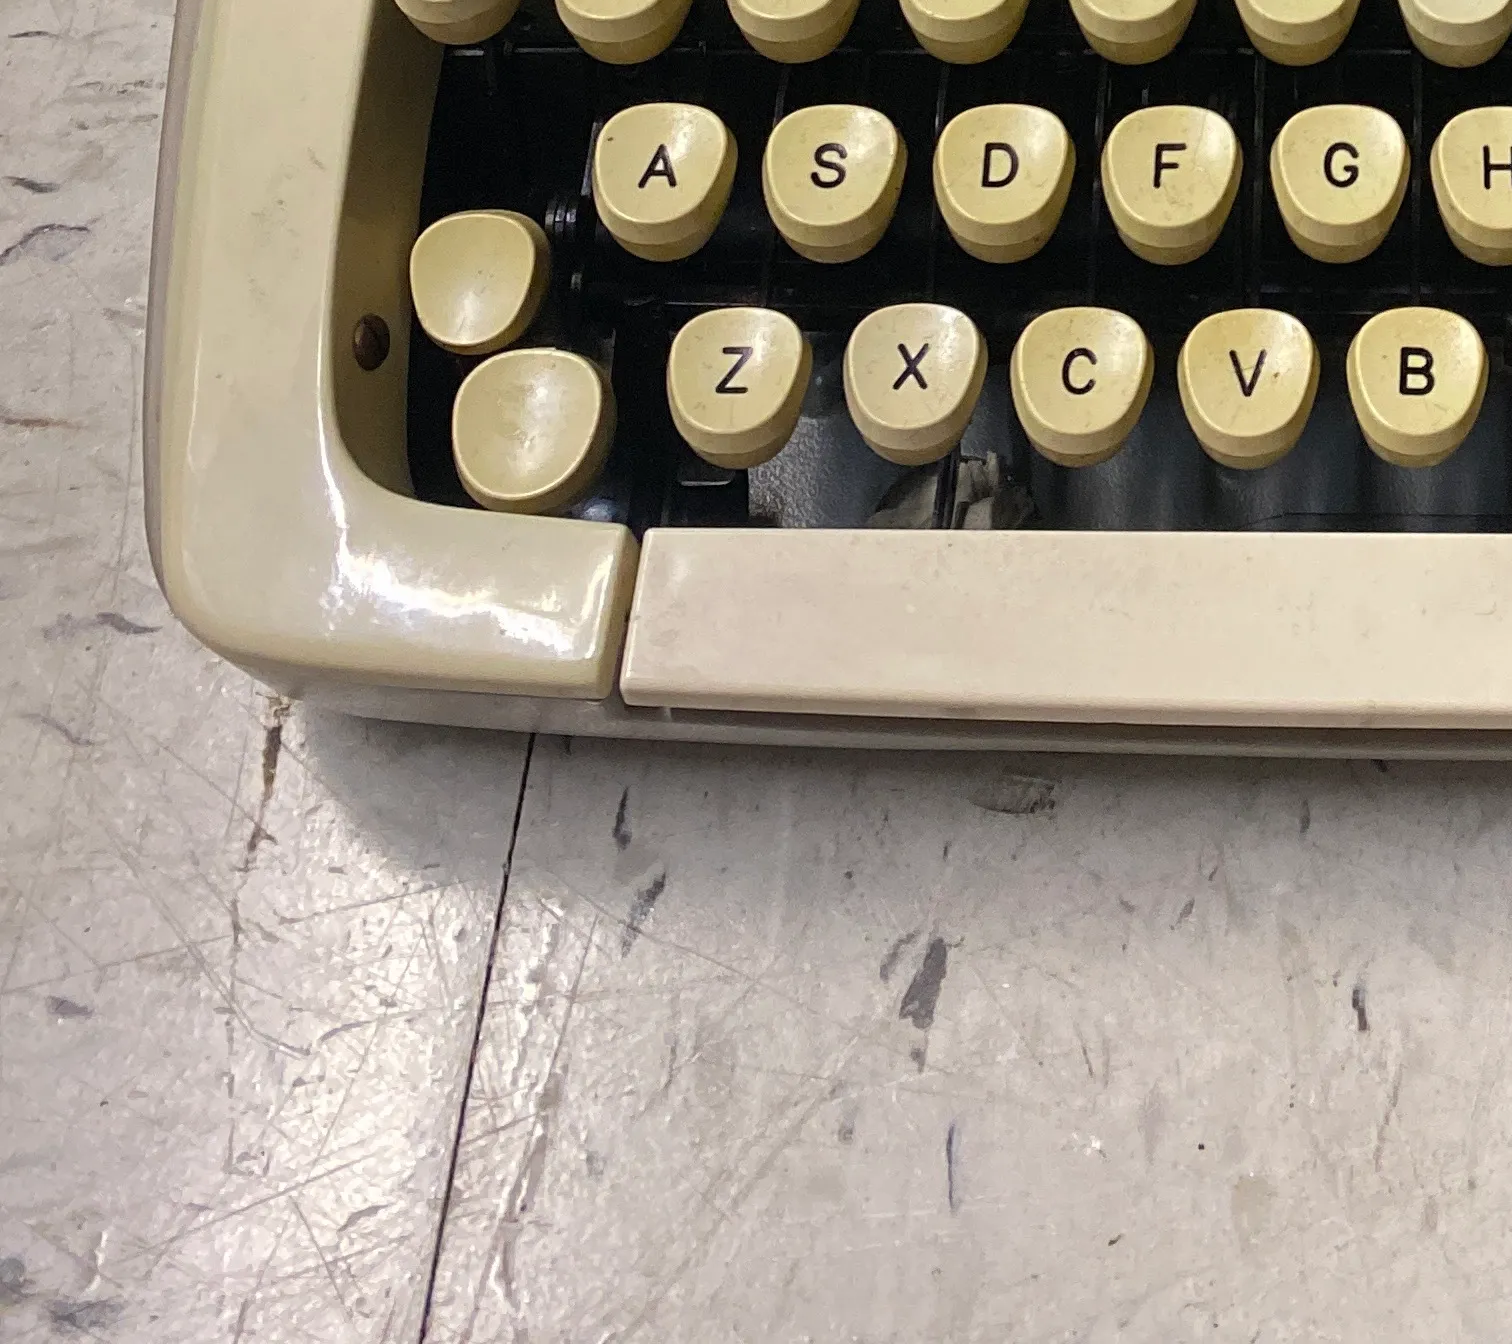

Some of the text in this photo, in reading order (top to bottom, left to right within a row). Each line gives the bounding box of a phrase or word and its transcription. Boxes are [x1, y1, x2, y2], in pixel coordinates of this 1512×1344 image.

[638, 144, 678, 188] A
[810, 143, 846, 188] S
[981, 142, 1019, 188] D
[1153, 142, 1187, 188] F
[1323, 141, 1359, 188] G
[715, 347, 754, 394] Z
[892, 343, 930, 390] X
[1061, 348, 1097, 395] C
[1228, 349, 1267, 397] V
[1399, 347, 1435, 396] B
